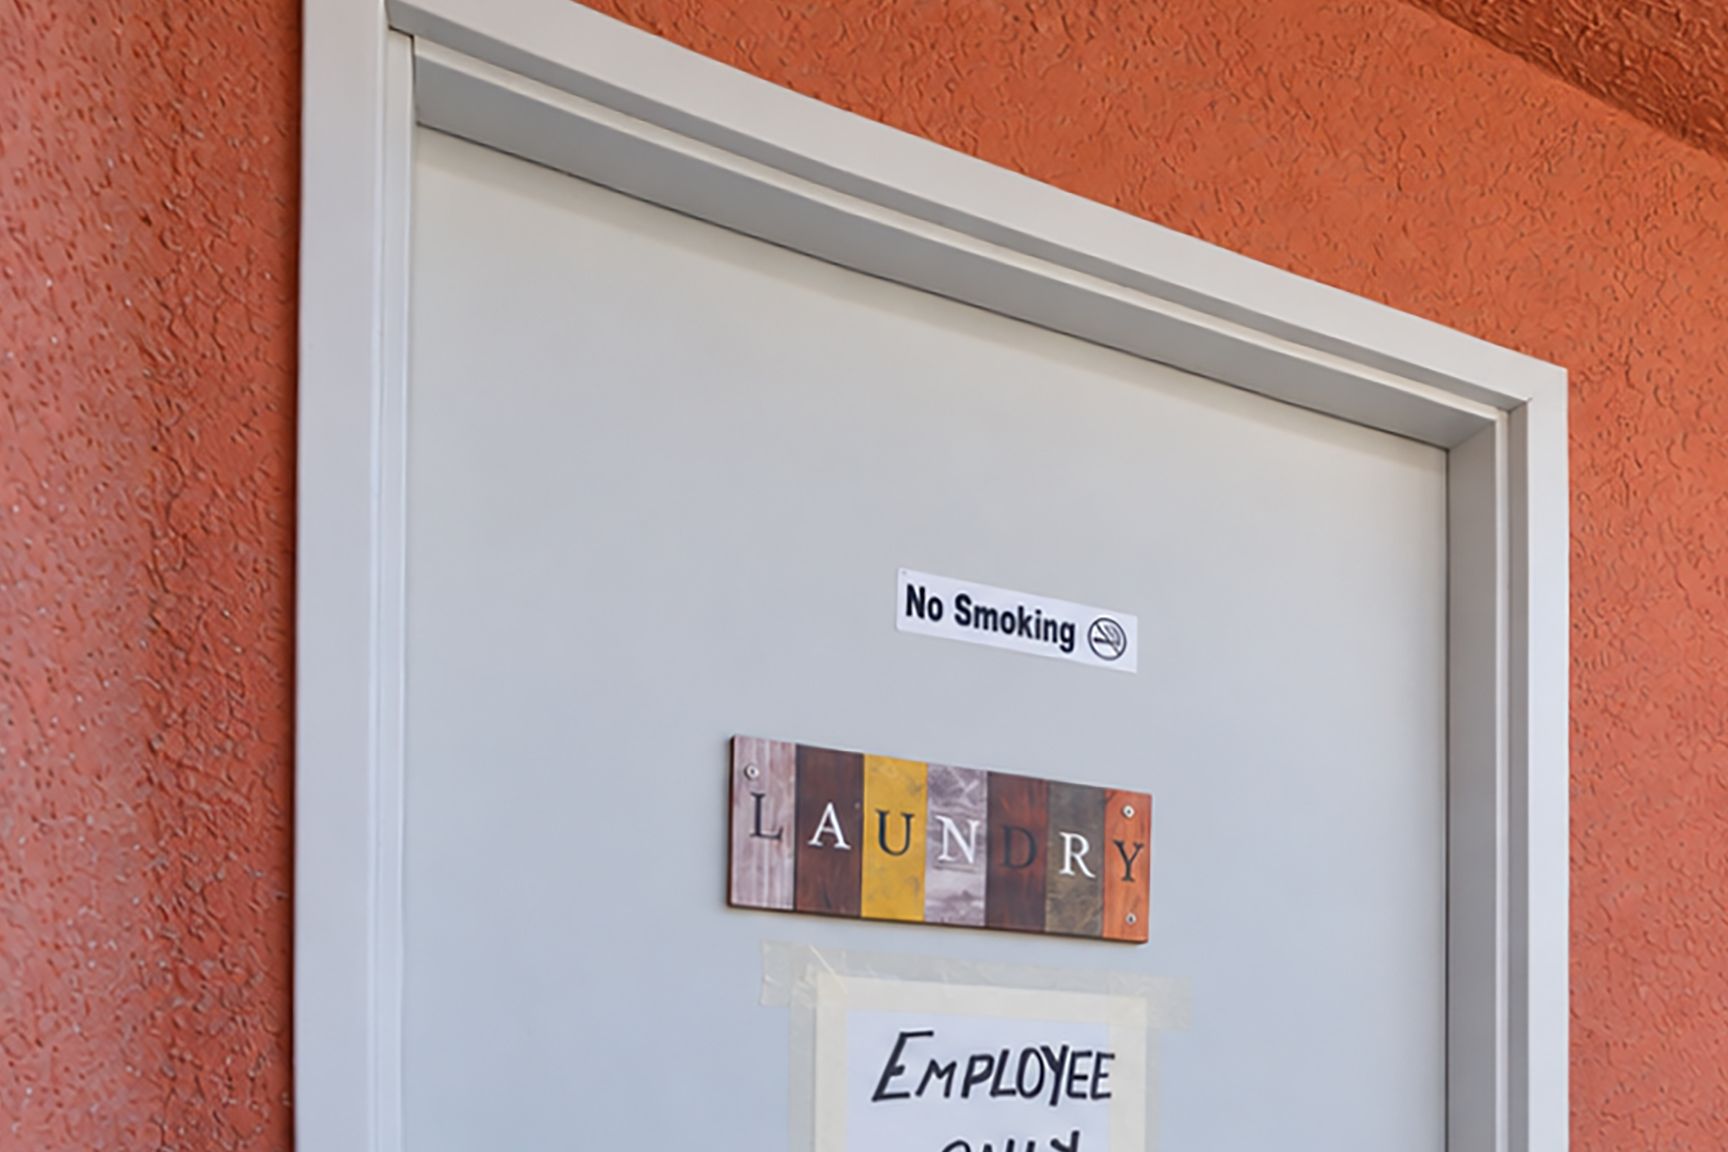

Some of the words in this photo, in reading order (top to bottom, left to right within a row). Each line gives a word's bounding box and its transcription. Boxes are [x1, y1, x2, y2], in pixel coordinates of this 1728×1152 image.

[905, 583, 943, 622] No
[953, 593, 1076, 653] Smoking
[750, 792, 1144, 883] LAUNDRY
[871, 1030, 1116, 1107] EMPLOYEE
